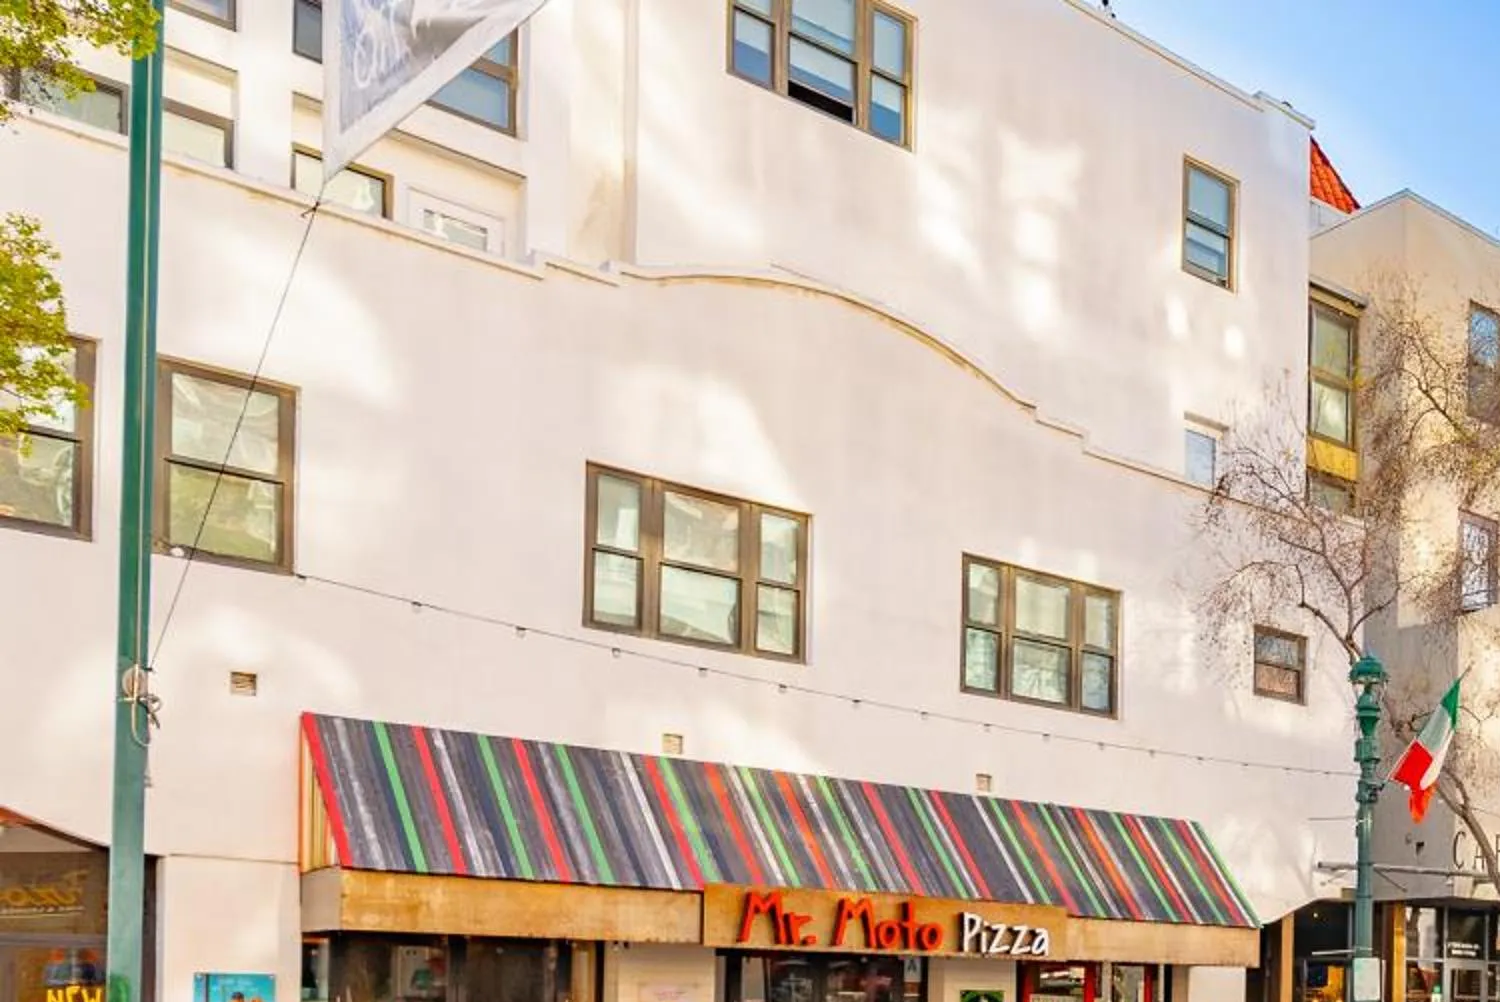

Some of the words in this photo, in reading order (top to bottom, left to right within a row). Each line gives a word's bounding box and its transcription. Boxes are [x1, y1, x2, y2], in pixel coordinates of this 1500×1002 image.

[736, 891, 818, 946] Mr.
[830, 896, 945, 950] Moto
[960, 911, 1050, 957] Pizza
